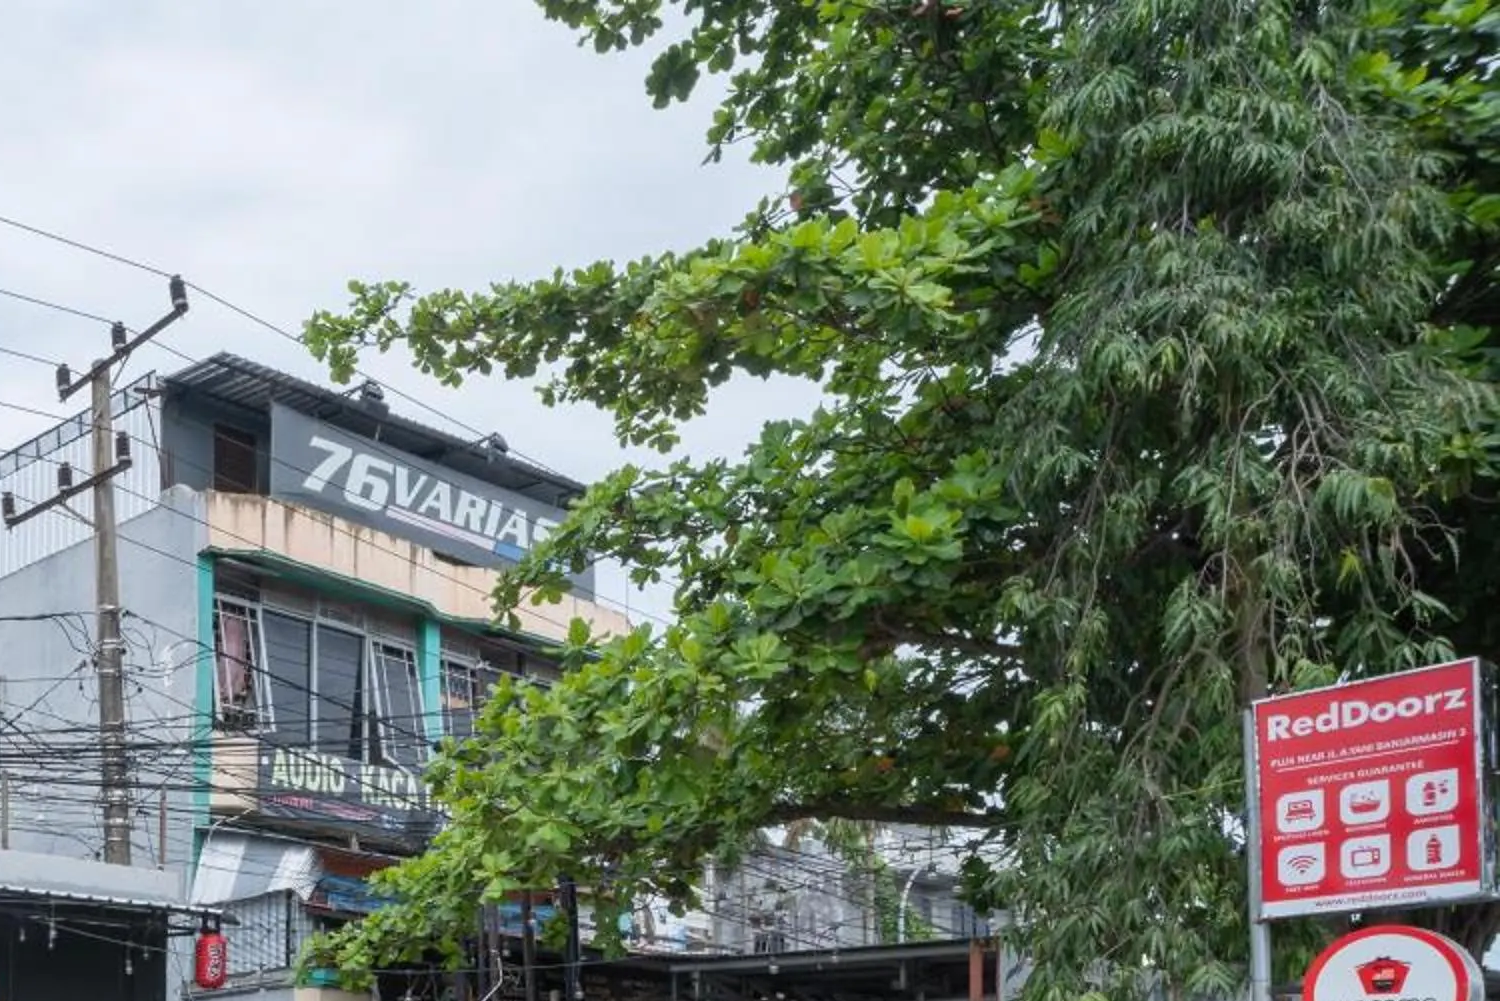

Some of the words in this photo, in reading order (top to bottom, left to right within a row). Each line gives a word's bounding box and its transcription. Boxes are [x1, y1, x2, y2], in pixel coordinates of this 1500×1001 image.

[302, 435, 394, 511] 76
[1267, 688, 1467, 741] RedDoorz
[272, 748, 345, 796] AUDIO
